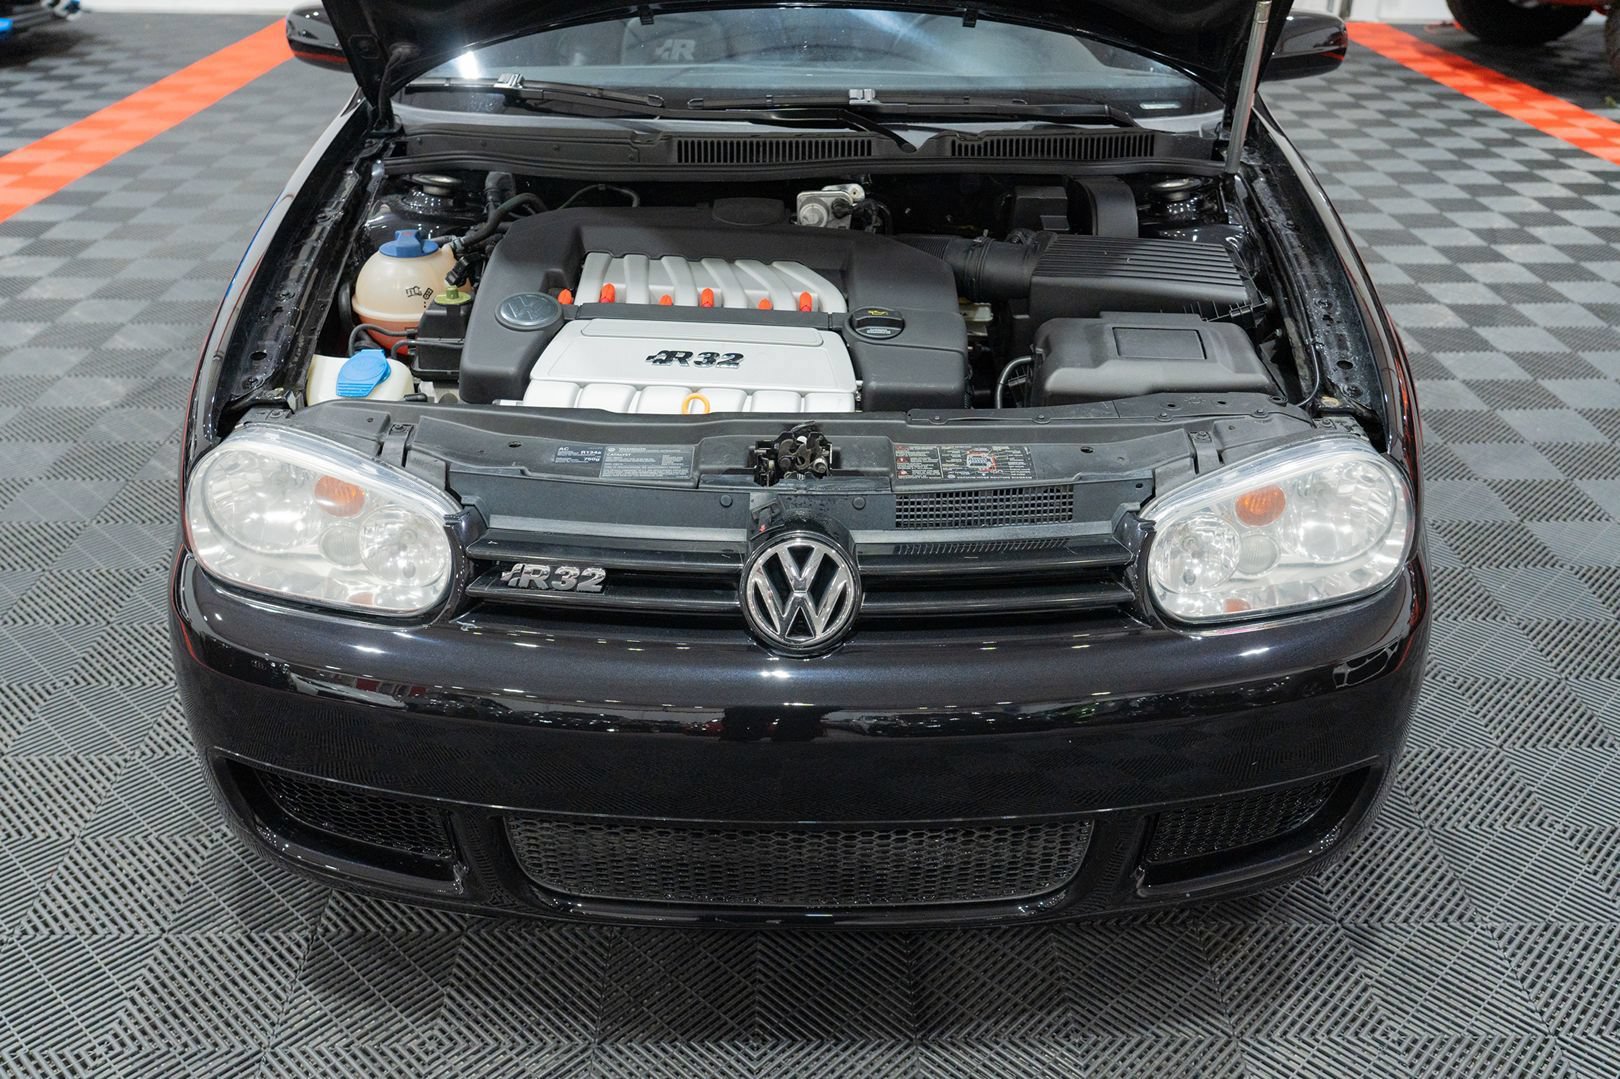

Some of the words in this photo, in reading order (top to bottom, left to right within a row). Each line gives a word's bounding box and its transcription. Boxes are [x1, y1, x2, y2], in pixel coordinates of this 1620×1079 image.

[664, 350, 744, 369] R32
[517, 563, 606, 592] R32
[747, 538, 854, 646] VW
